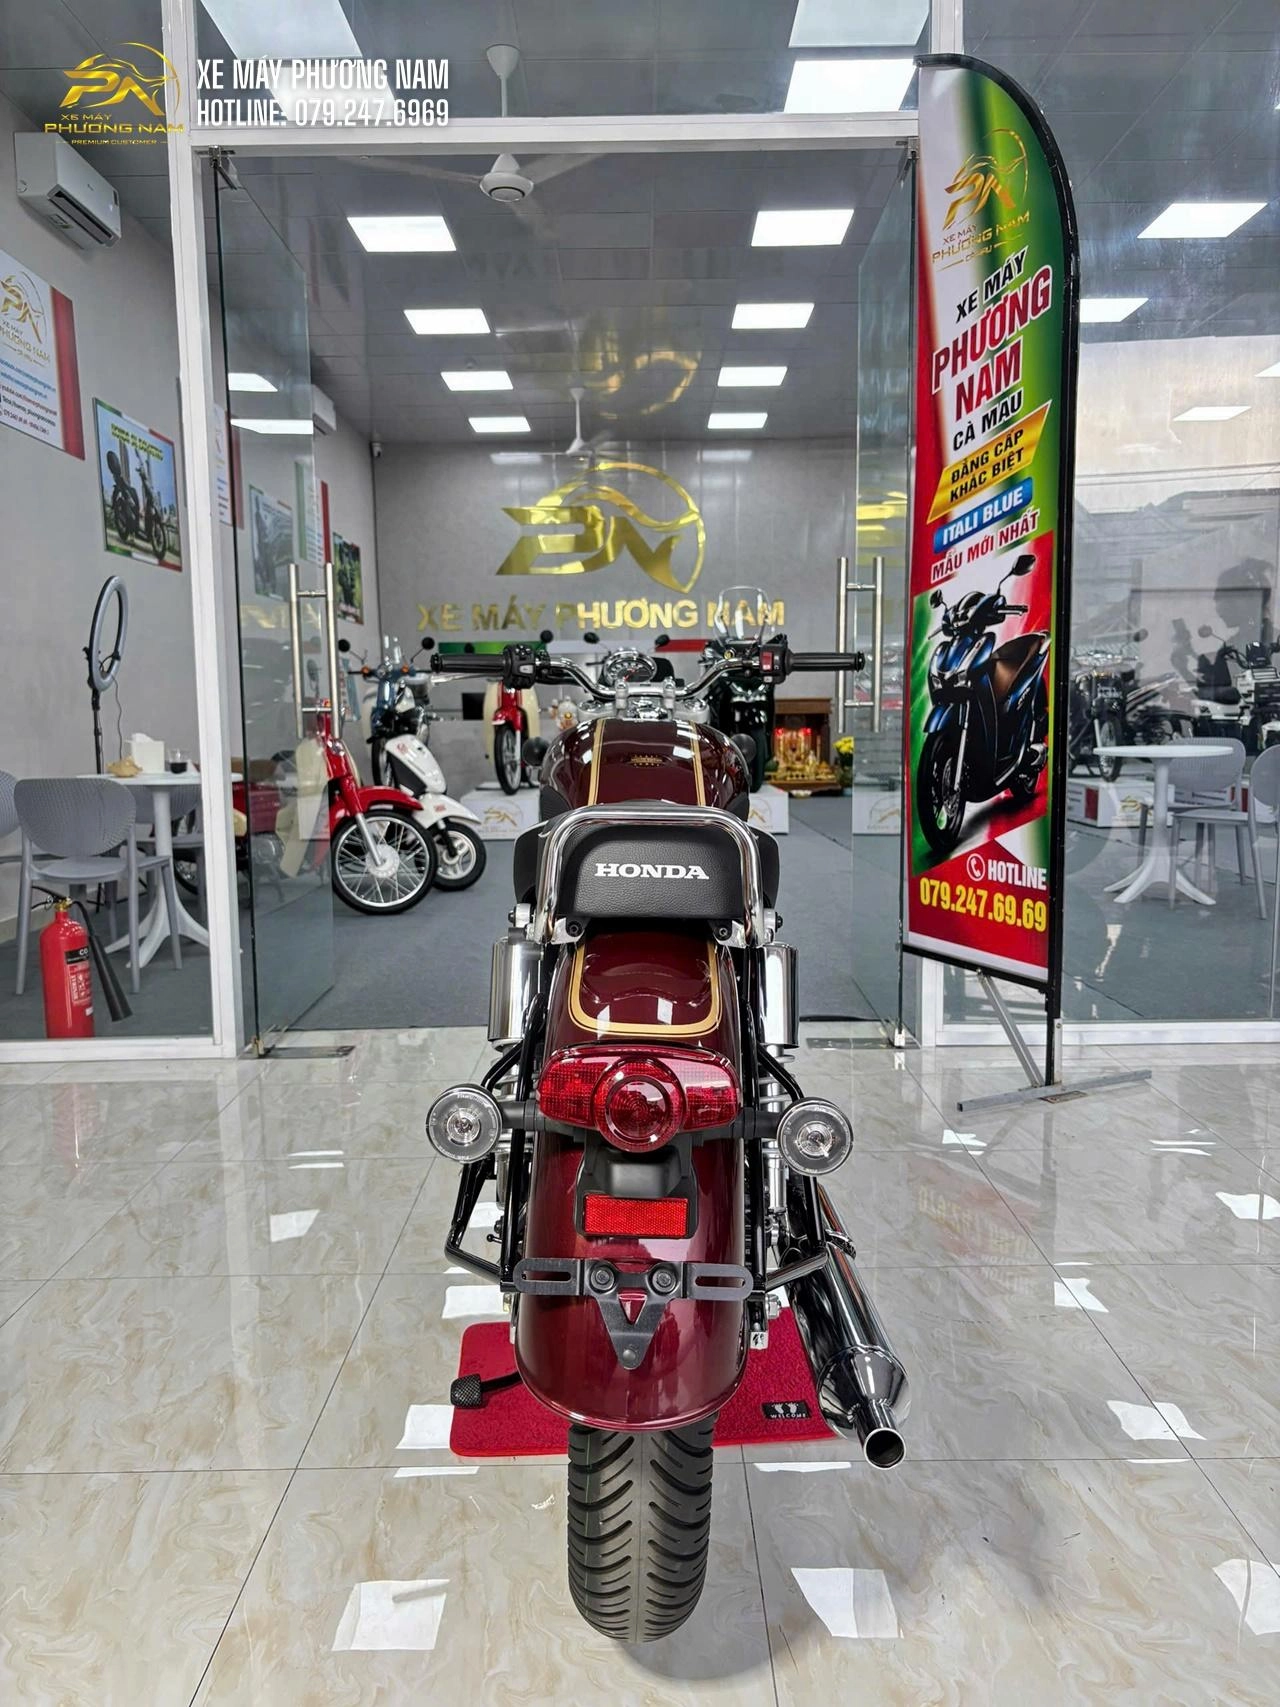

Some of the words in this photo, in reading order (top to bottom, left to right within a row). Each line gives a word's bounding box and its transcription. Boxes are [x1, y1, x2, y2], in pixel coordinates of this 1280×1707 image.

[956, 288, 978, 324] XE
[984, 248, 1029, 301] MÁY
[933, 266, 1052, 392] PHƯƠNG
[955, 338, 1022, 422] NAM
[953, 421, 976, 451] CÀ
[981, 390, 1023, 433] MAU
[994, 429, 1024, 458] CẤP
[950, 473, 988, 503] KHÁC
[991, 447, 1025, 479] BIỆT
[942, 515, 979, 545] ITALI
[983, 487, 1024, 521] BLUE
[931, 548, 963, 582] MẪU
[967, 534, 995, 560] MỚI
[998, 508, 1039, 543] NHẤT
[416, 604, 462, 631] XE
[471, 594, 546, 631] MÁY
[556, 598, 699, 629] PHƯƠNG
[707, 600, 784, 627] NAM
[594, 863, 710, 880] HONDA
[988, 859, 1047, 891] HOTLINE
[919, 877, 1047, 933] 079.247.69.69
